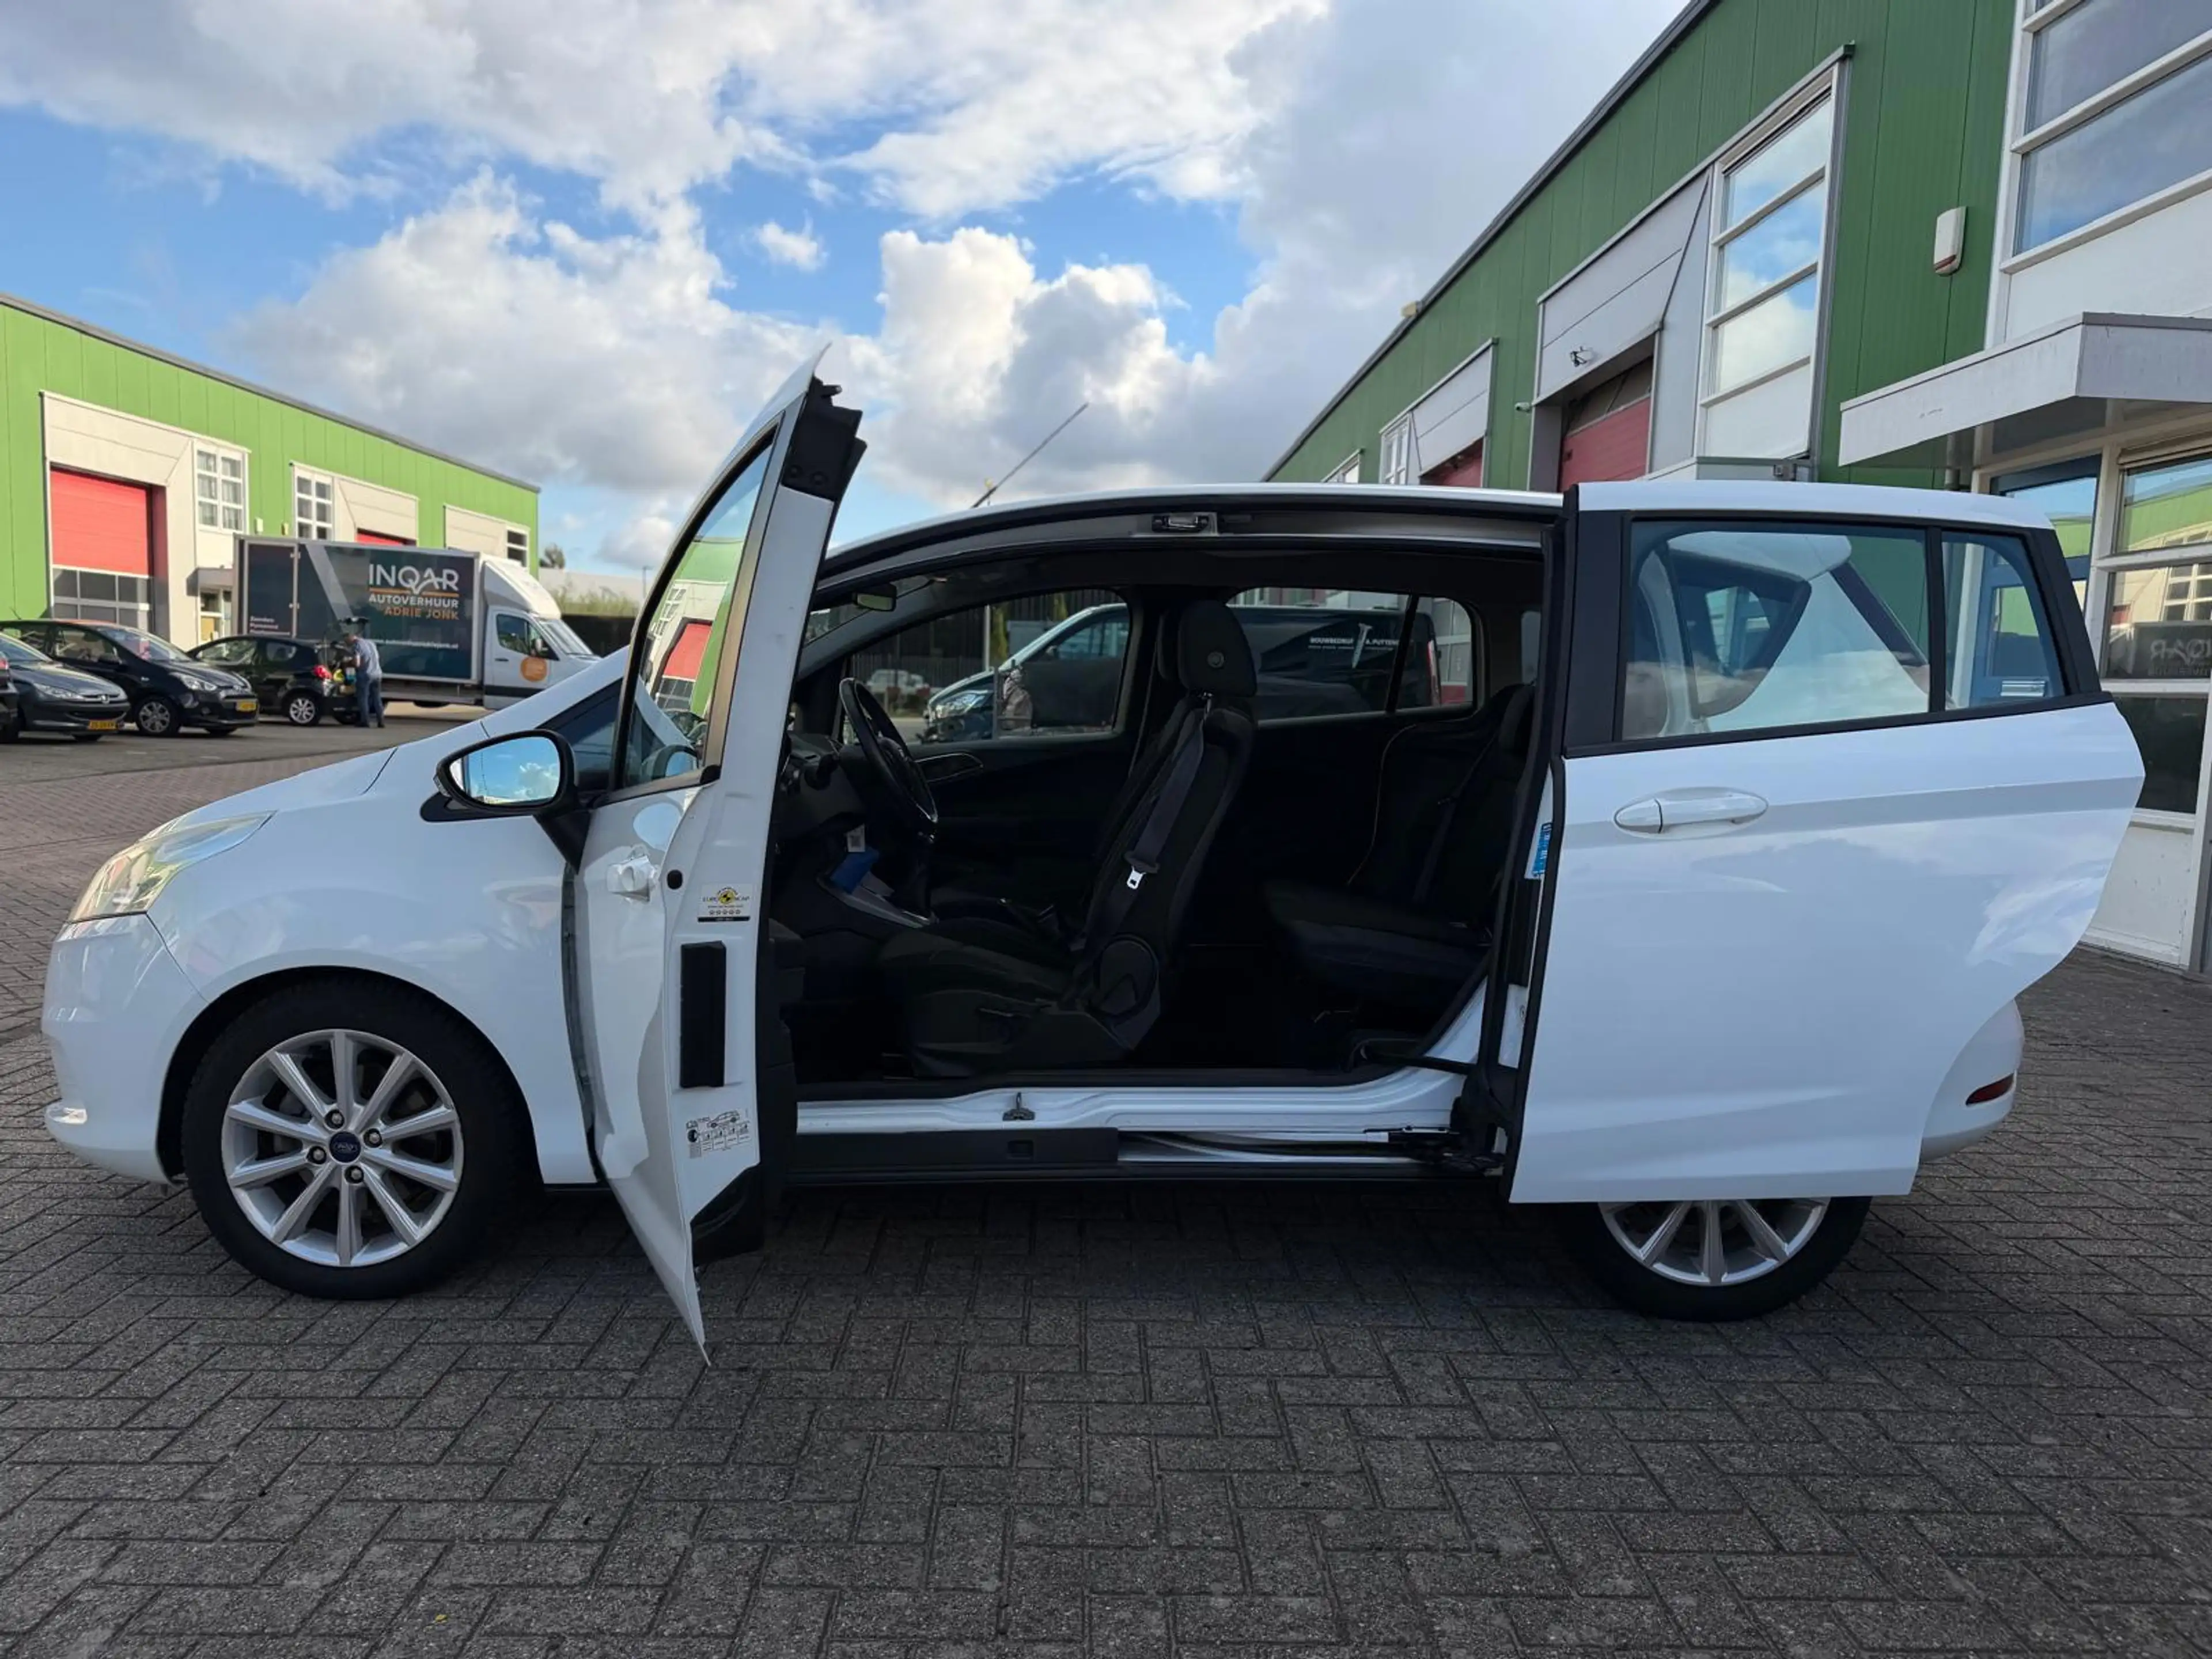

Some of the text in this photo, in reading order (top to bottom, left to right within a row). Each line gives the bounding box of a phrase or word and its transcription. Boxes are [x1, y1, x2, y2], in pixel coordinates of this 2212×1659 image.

[369, 563, 459, 594] INQAR
[369, 594, 459, 608] AUTOVERHUUR
[384, 607, 460, 620] ADRIE JONK
